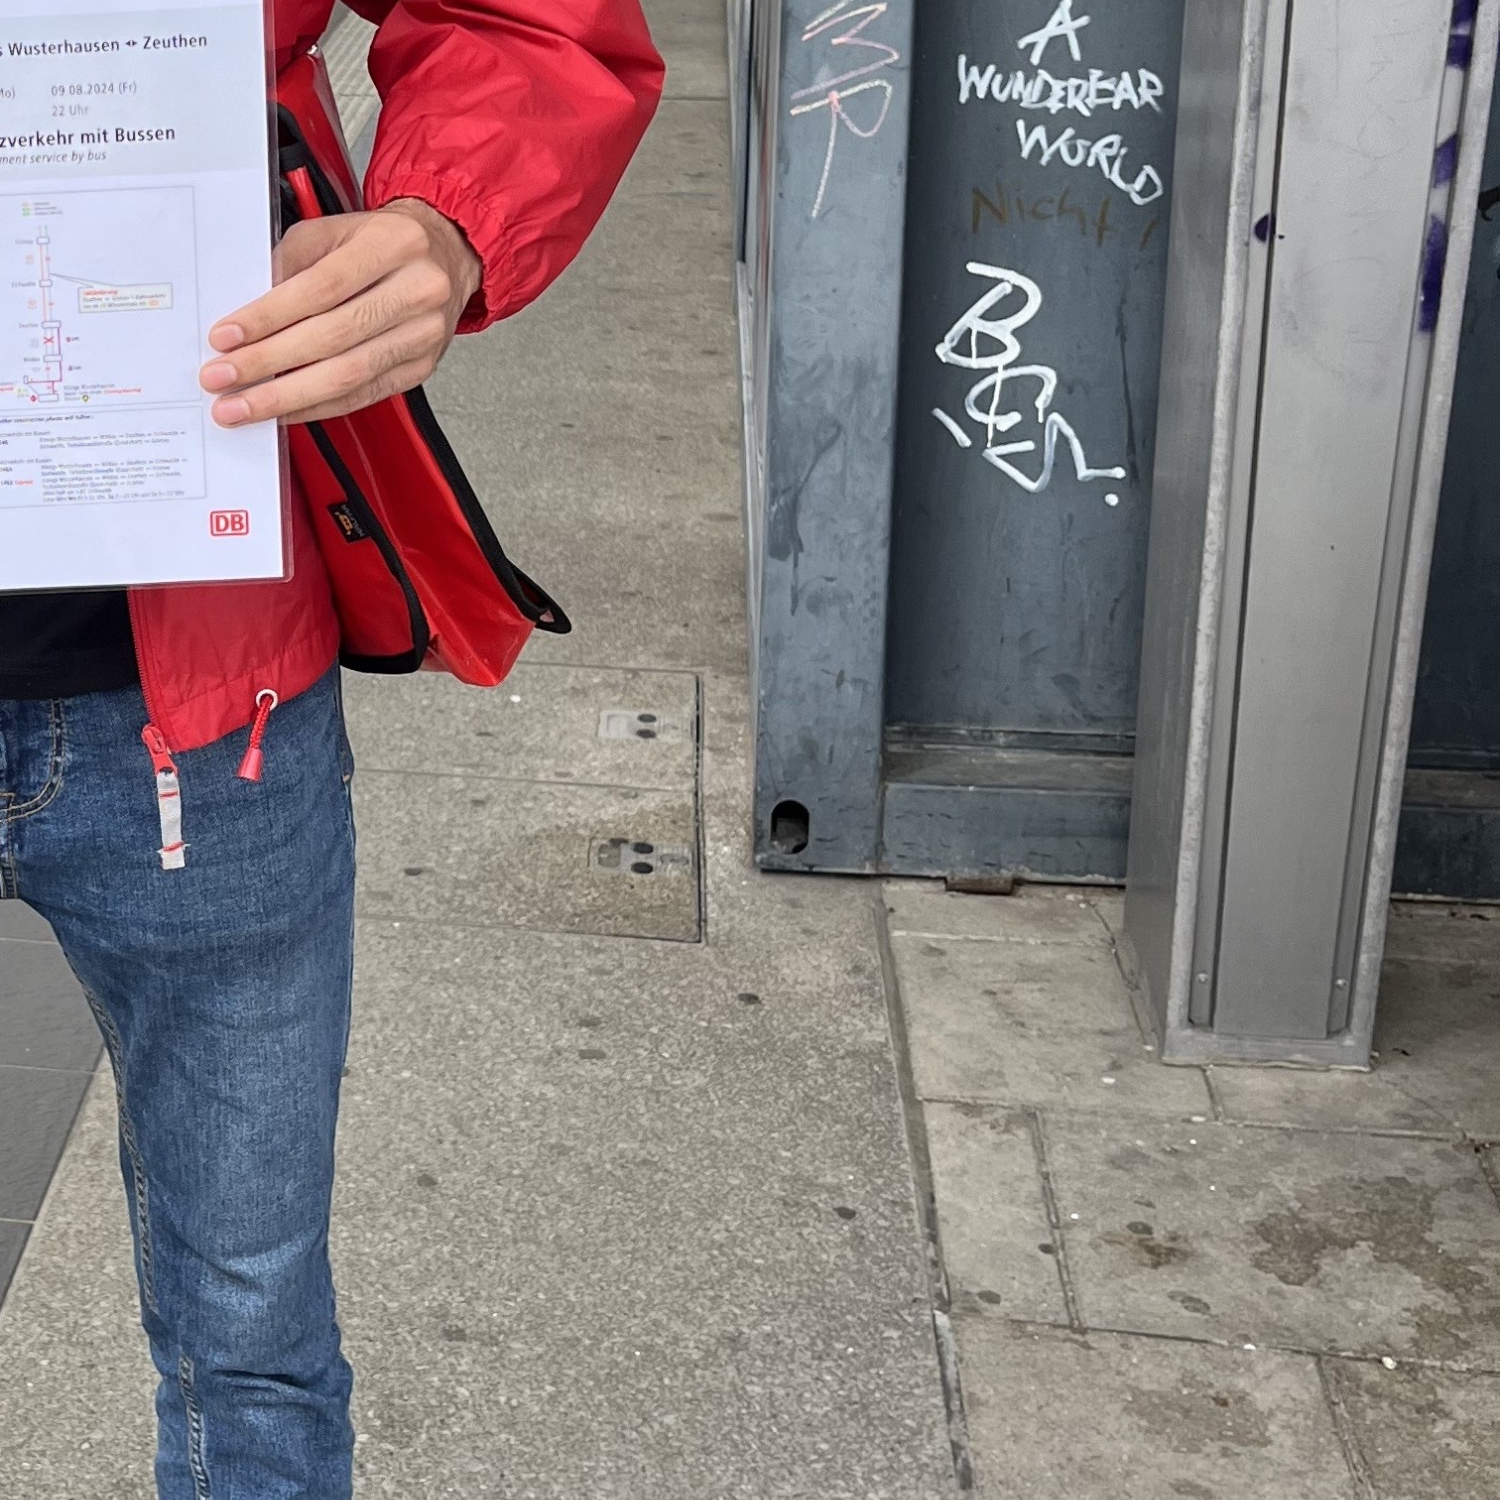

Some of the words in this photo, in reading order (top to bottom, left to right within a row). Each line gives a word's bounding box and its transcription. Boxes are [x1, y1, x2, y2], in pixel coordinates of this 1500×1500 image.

[7, 39, 120, 56] Wusterhausen
[142, 33, 207, 50] Zeuthen
[118, 80, 138, 95] (Fr)
[51, 105, 66, 117] 22
[69, 104, 90, 117] Uhr
[80, 128, 109, 145] mit
[114, 127, 176, 143] Bussen
[30, 152, 68, 164] service
[71, 150, 85, 164] by
[87, 149, 107, 161] bus
[214, 513, 246, 533] DB
